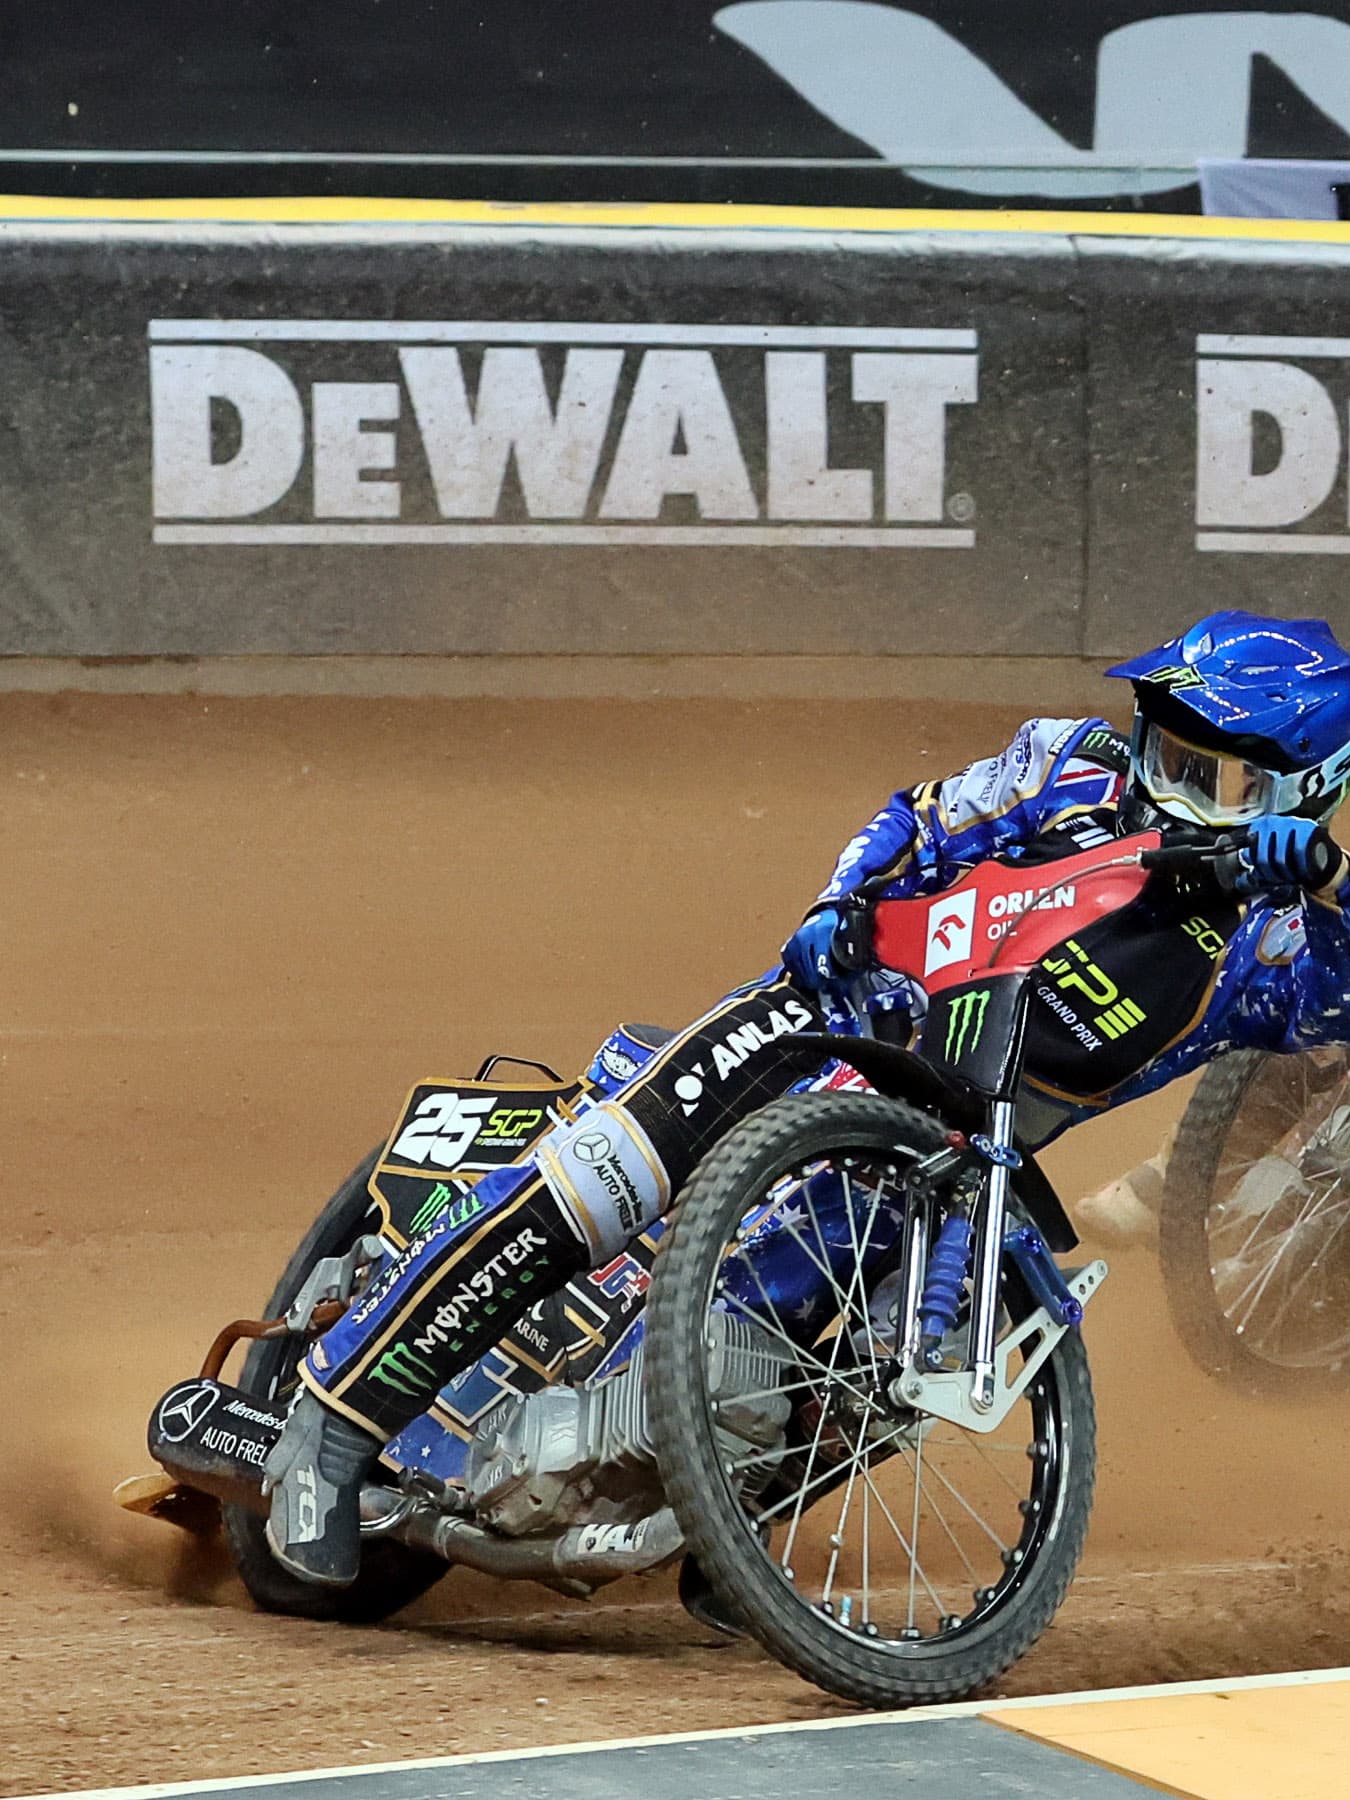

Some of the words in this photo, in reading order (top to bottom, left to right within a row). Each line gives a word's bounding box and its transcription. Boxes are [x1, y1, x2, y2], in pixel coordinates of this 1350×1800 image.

[150, 345, 977, 522] DEWALT
[989, 885, 1075, 918] ORLEN
[1037, 986, 1077, 1025] GRAND
[1071, 1023, 1103, 1052] PRIX
[712, 1000, 813, 1081] ANLAS
[392, 1093, 498, 1168] 25
[480, 1109, 543, 1137] SGP
[593, 1164, 620, 1197] AUTO
[513, 1318, 550, 1352] ARINE
[222, 1400, 288, 1430] Mercedes-b
[200, 1427, 237, 1454] AUTO
[236, 1439, 269, 1466] FREL
